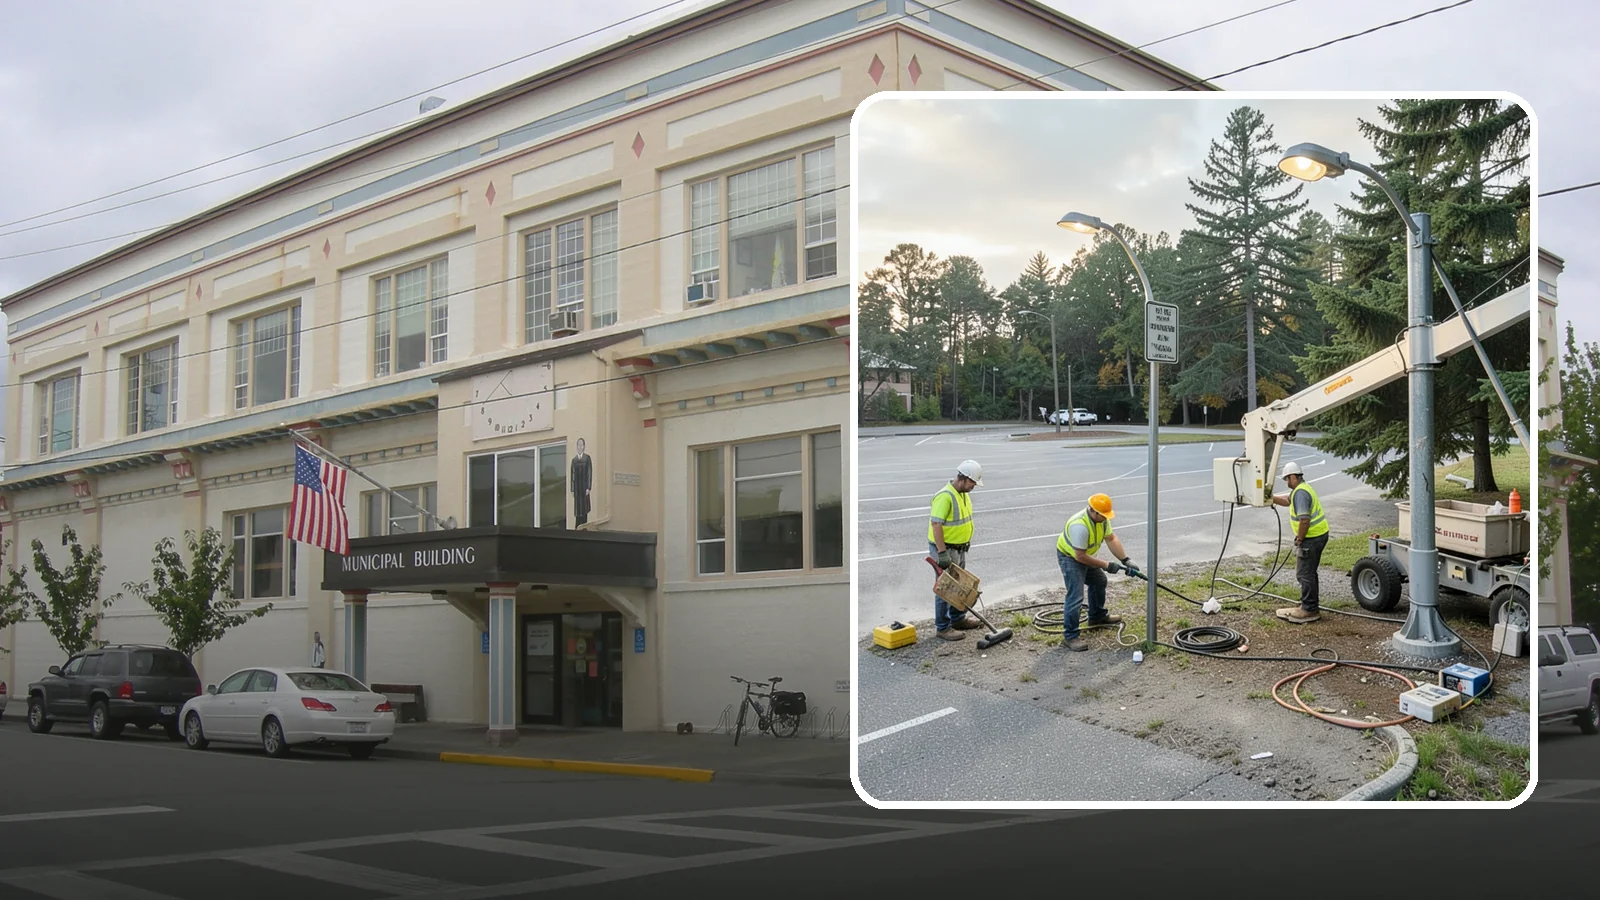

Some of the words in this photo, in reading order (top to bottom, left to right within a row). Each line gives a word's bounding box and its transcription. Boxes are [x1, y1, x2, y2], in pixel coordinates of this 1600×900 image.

[475, 390, 479, 398] 7
[536, 402, 540, 410] 4
[481, 407, 485, 415] 8
[529, 414, 533, 422] 3
[521, 420, 525, 428] 2
[508, 425, 513, 433] 12
[342, 552, 405, 572] MUNICIPAL
[414, 546, 475, 567] BUILDING
